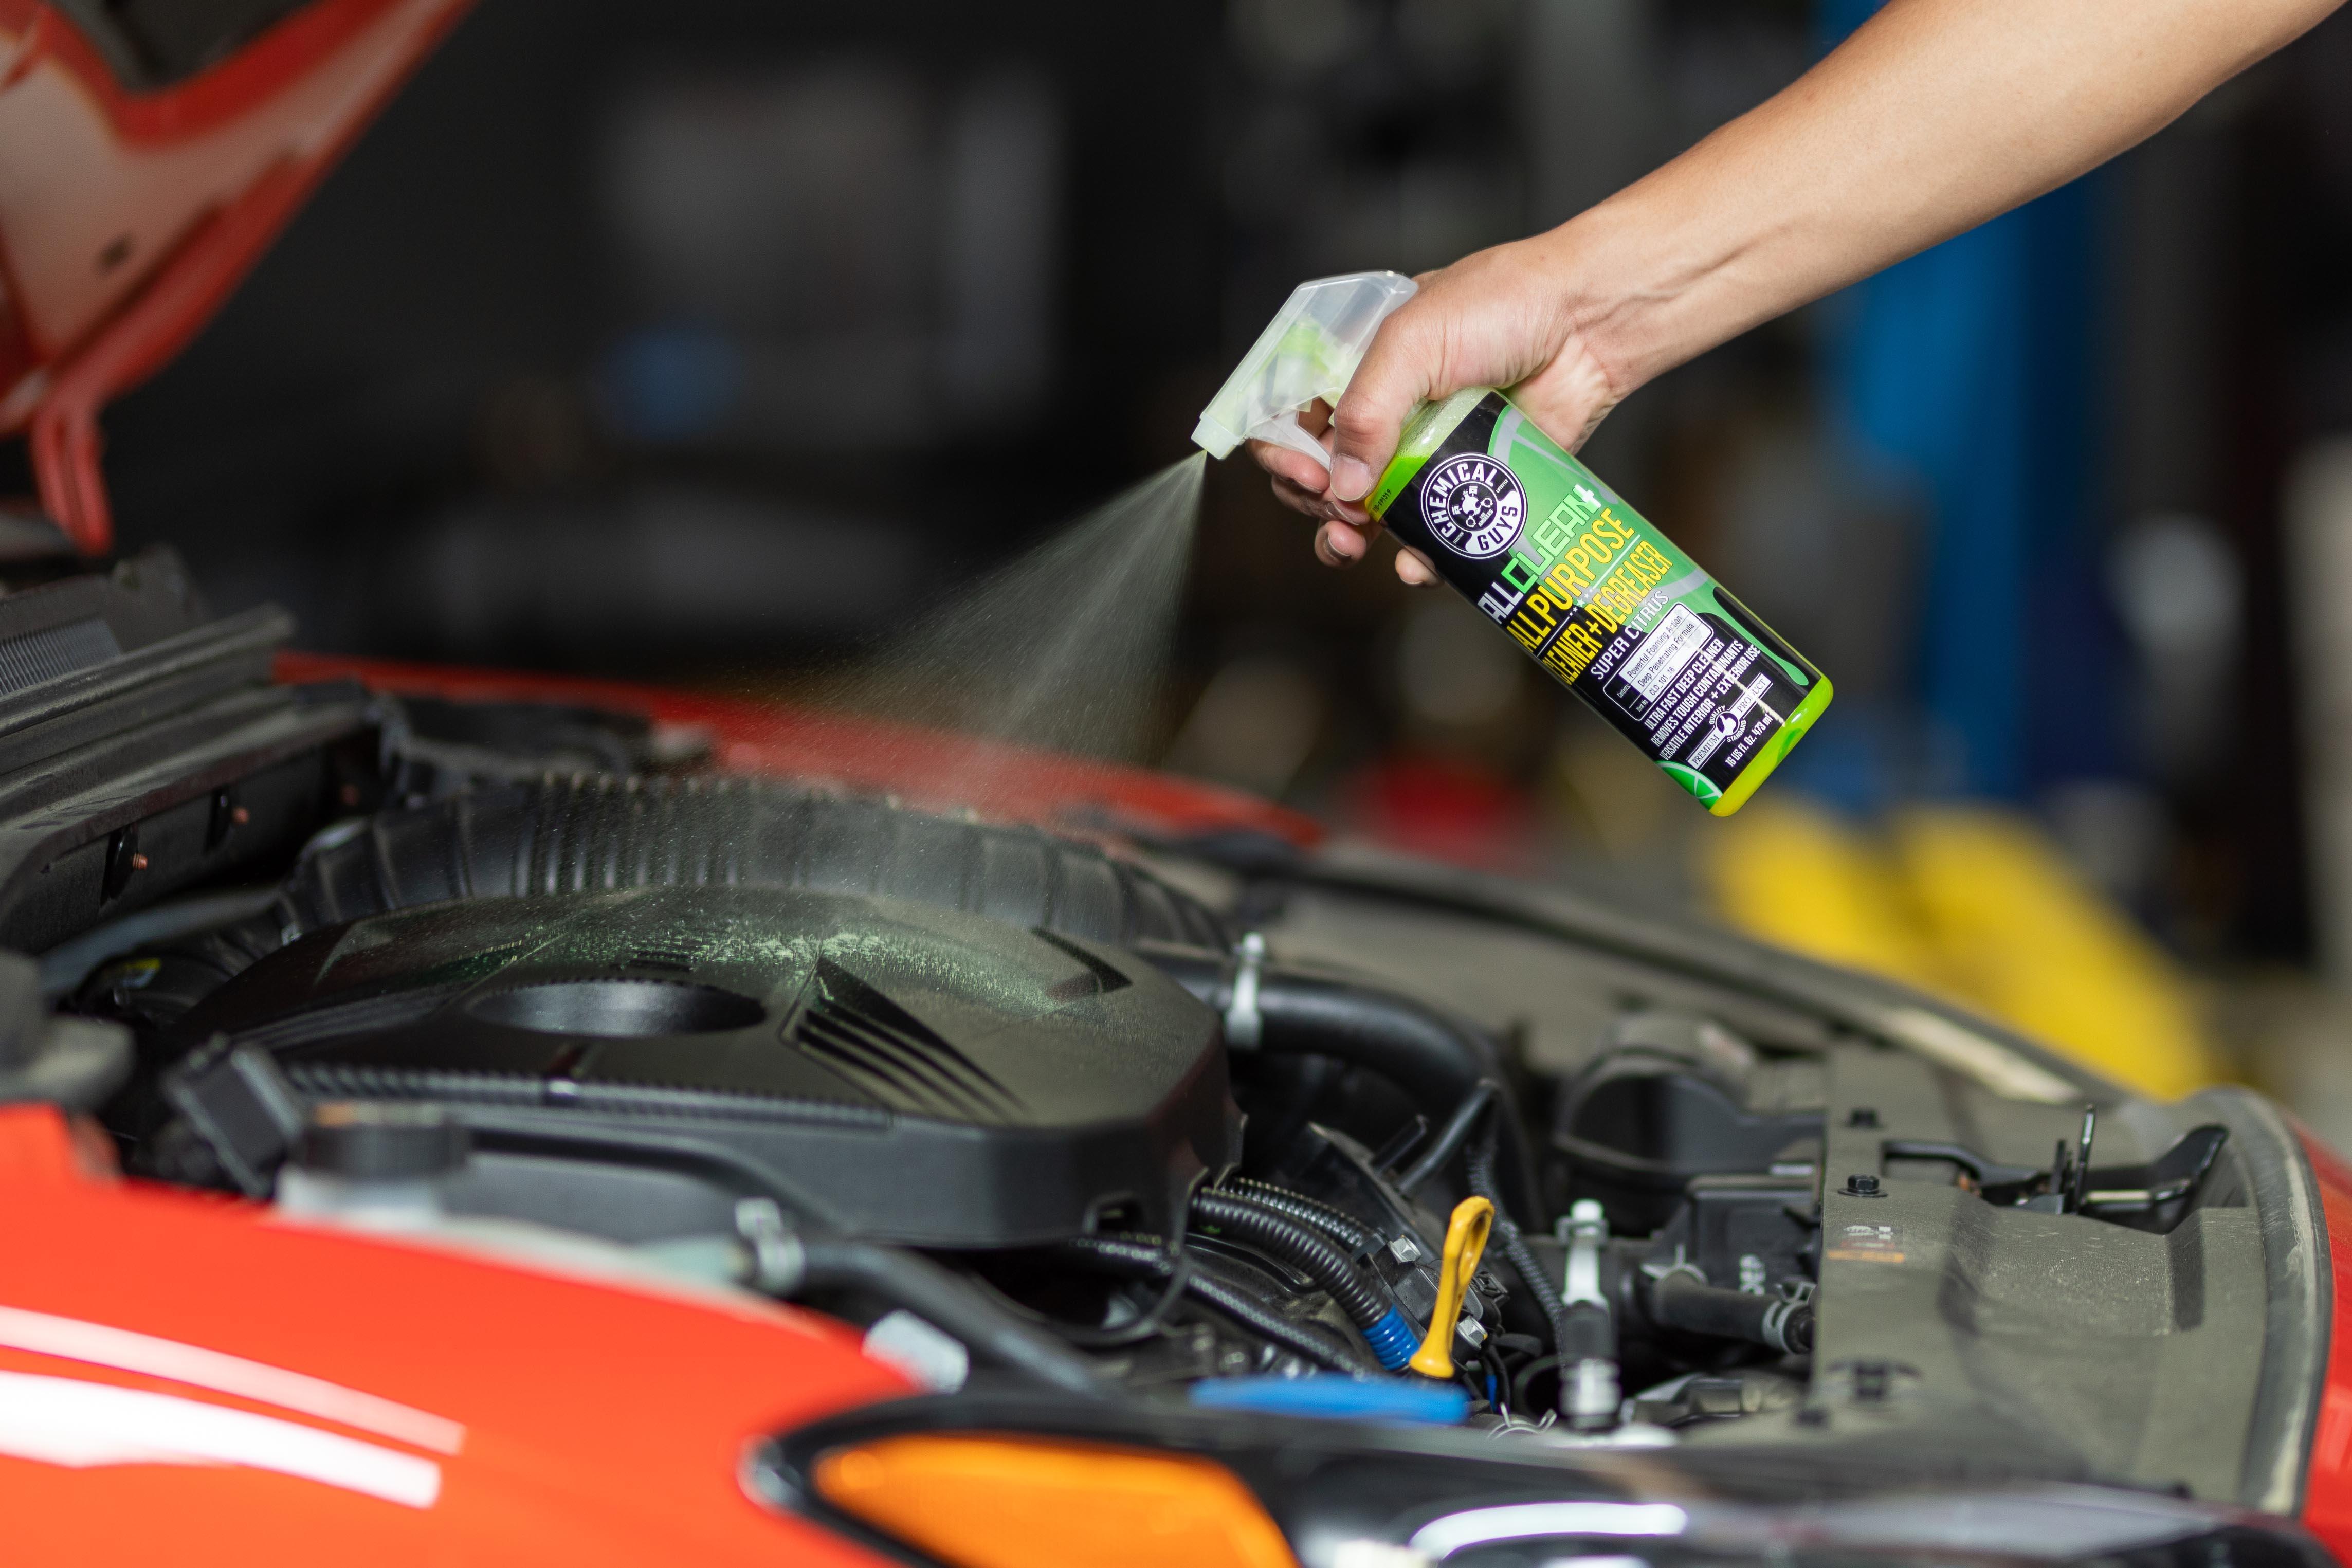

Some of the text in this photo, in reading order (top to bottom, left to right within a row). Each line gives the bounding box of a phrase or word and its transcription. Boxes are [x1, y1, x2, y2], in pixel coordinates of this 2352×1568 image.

[1430, 463, 1518, 551] CHEMICAL GUYS
[1478, 509, 1493, 527] ANGELES
[1591, 591, 1669, 680] SUPER CITRUS
[1627, 615, 1683, 678] Powerful Foaming Action
[1638, 623, 1694, 687] Deep Penetrating Formula
[1644, 637, 1725, 731] ULTRA FAST DEEP CLEANER
[1649, 666, 1675, 696] CLD_101_16
[1650, 640, 1744, 747] REMOVES TOUGH CONTAMINANTS
[1659, 730, 1688, 760] VERSATILE
[1682, 698, 1716, 735] INTERIOR
[1717, 656, 1751, 695] EXTERIOR
[1745, 644, 1761, 662] USE
[1709, 705, 1725, 724] QUALITY
[1725, 758, 1736, 767] 16
[1731, 748, 1743, 761] US
[1744, 734, 1757, 746] Oz.
[1752, 721, 1766, 736] 473
[1762, 713, 1773, 726] ml
[1727, 720, 1746, 742] STANDARD
[1692, 734, 1720, 765] PREMIUM
